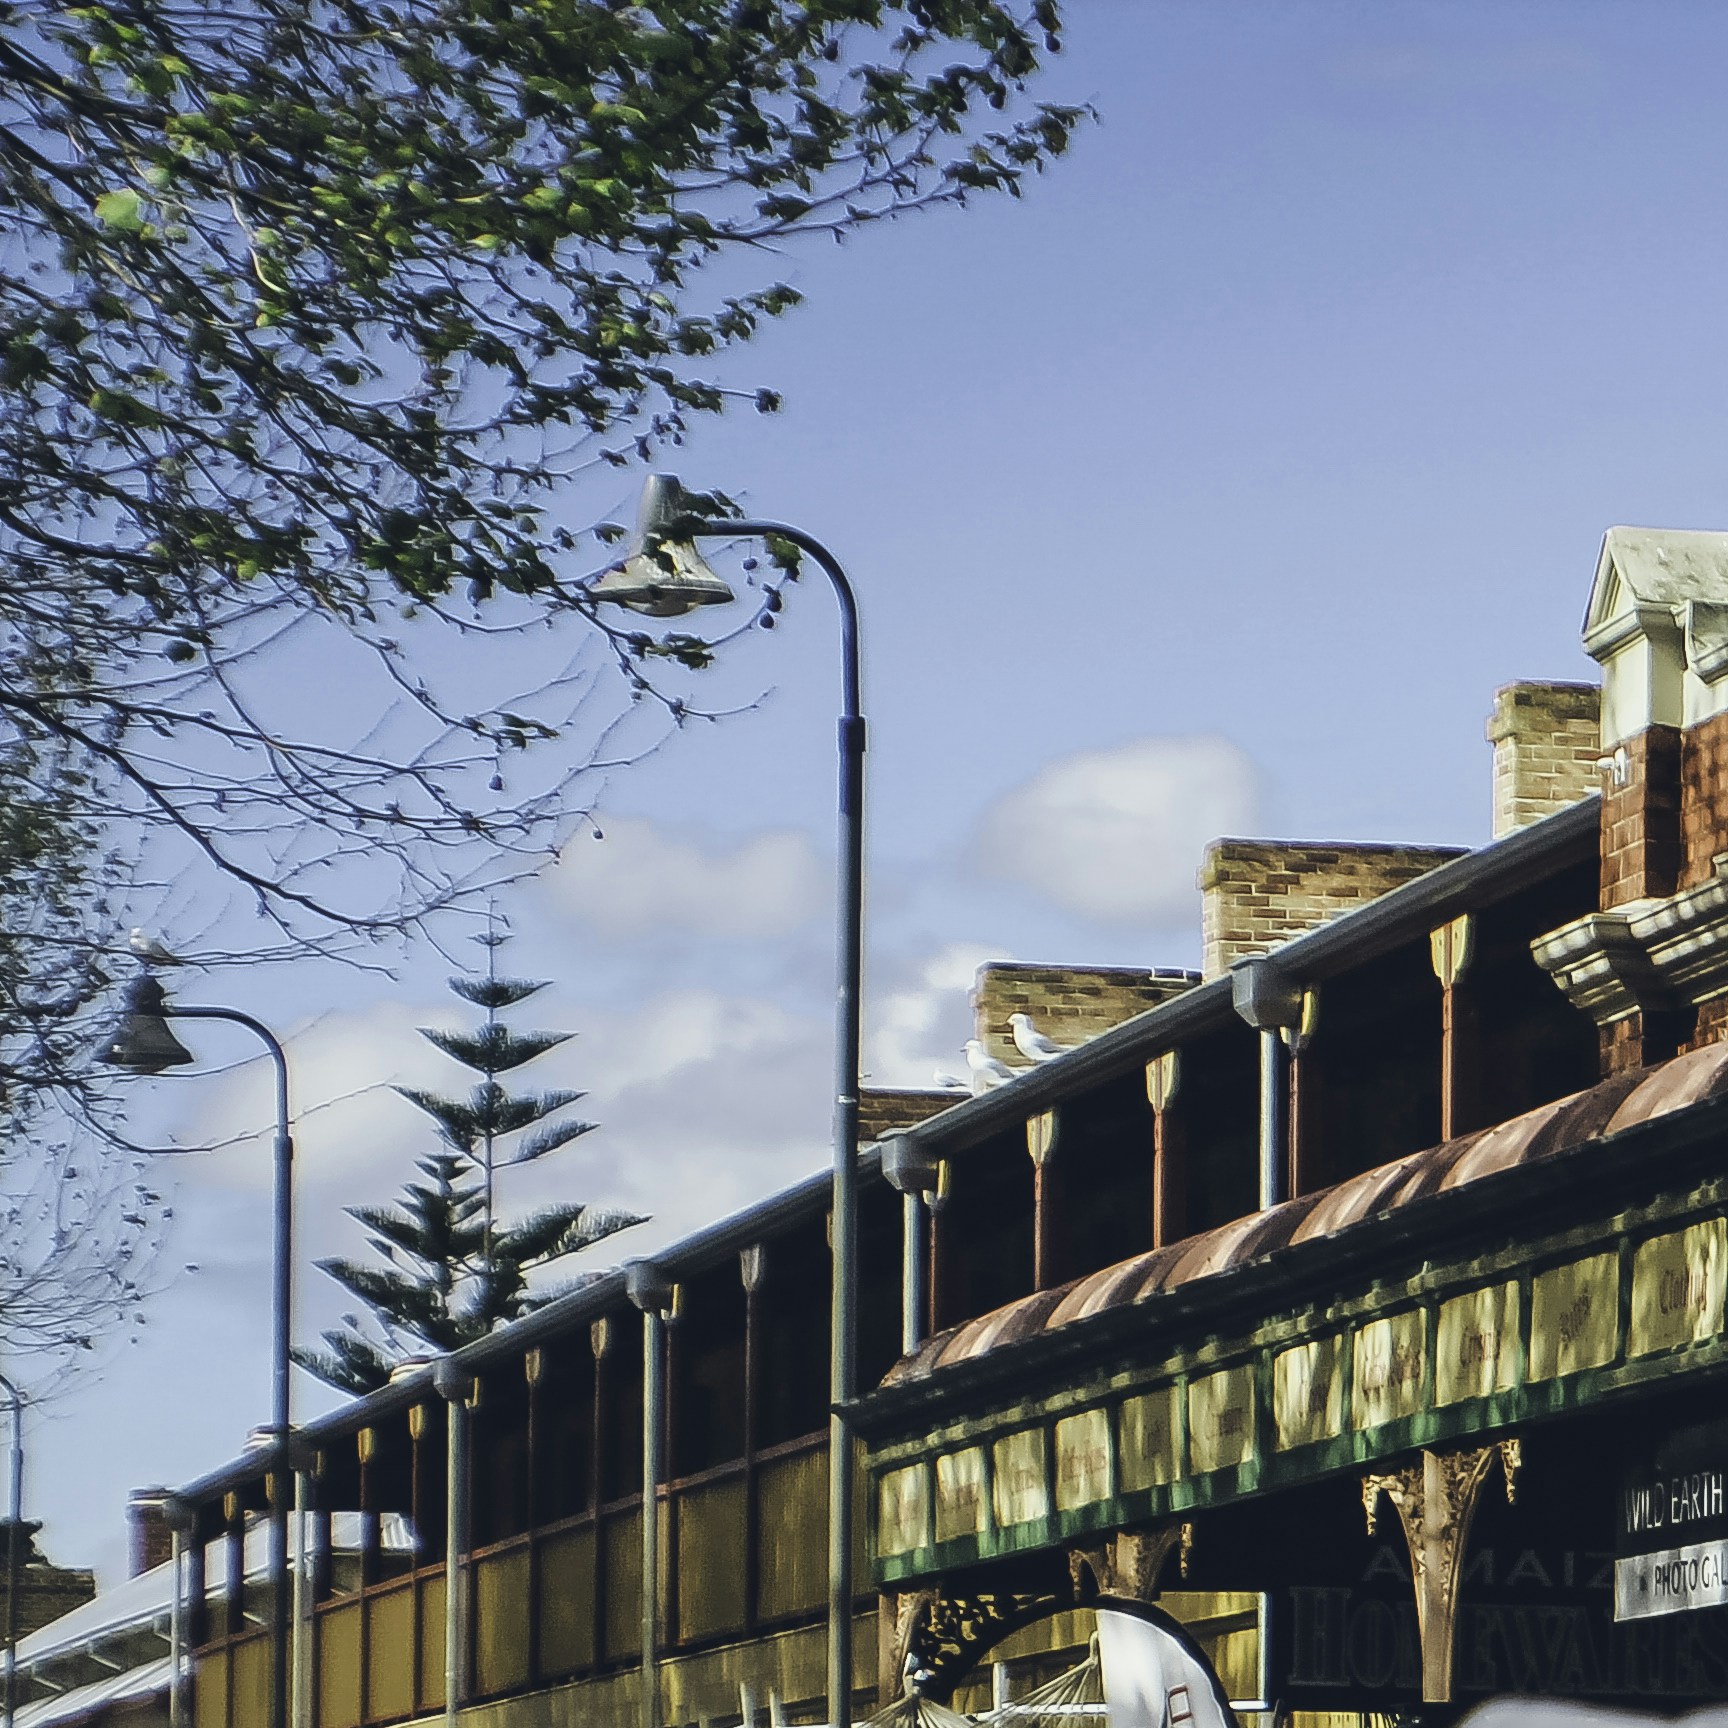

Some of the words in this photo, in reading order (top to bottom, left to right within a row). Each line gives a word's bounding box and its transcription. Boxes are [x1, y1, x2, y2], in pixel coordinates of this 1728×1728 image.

[1624, 1481, 1665, 1534] WILD
[1671, 1471, 1724, 1524] EARTH
[1654, 1556, 1698, 1597] PHOTO
